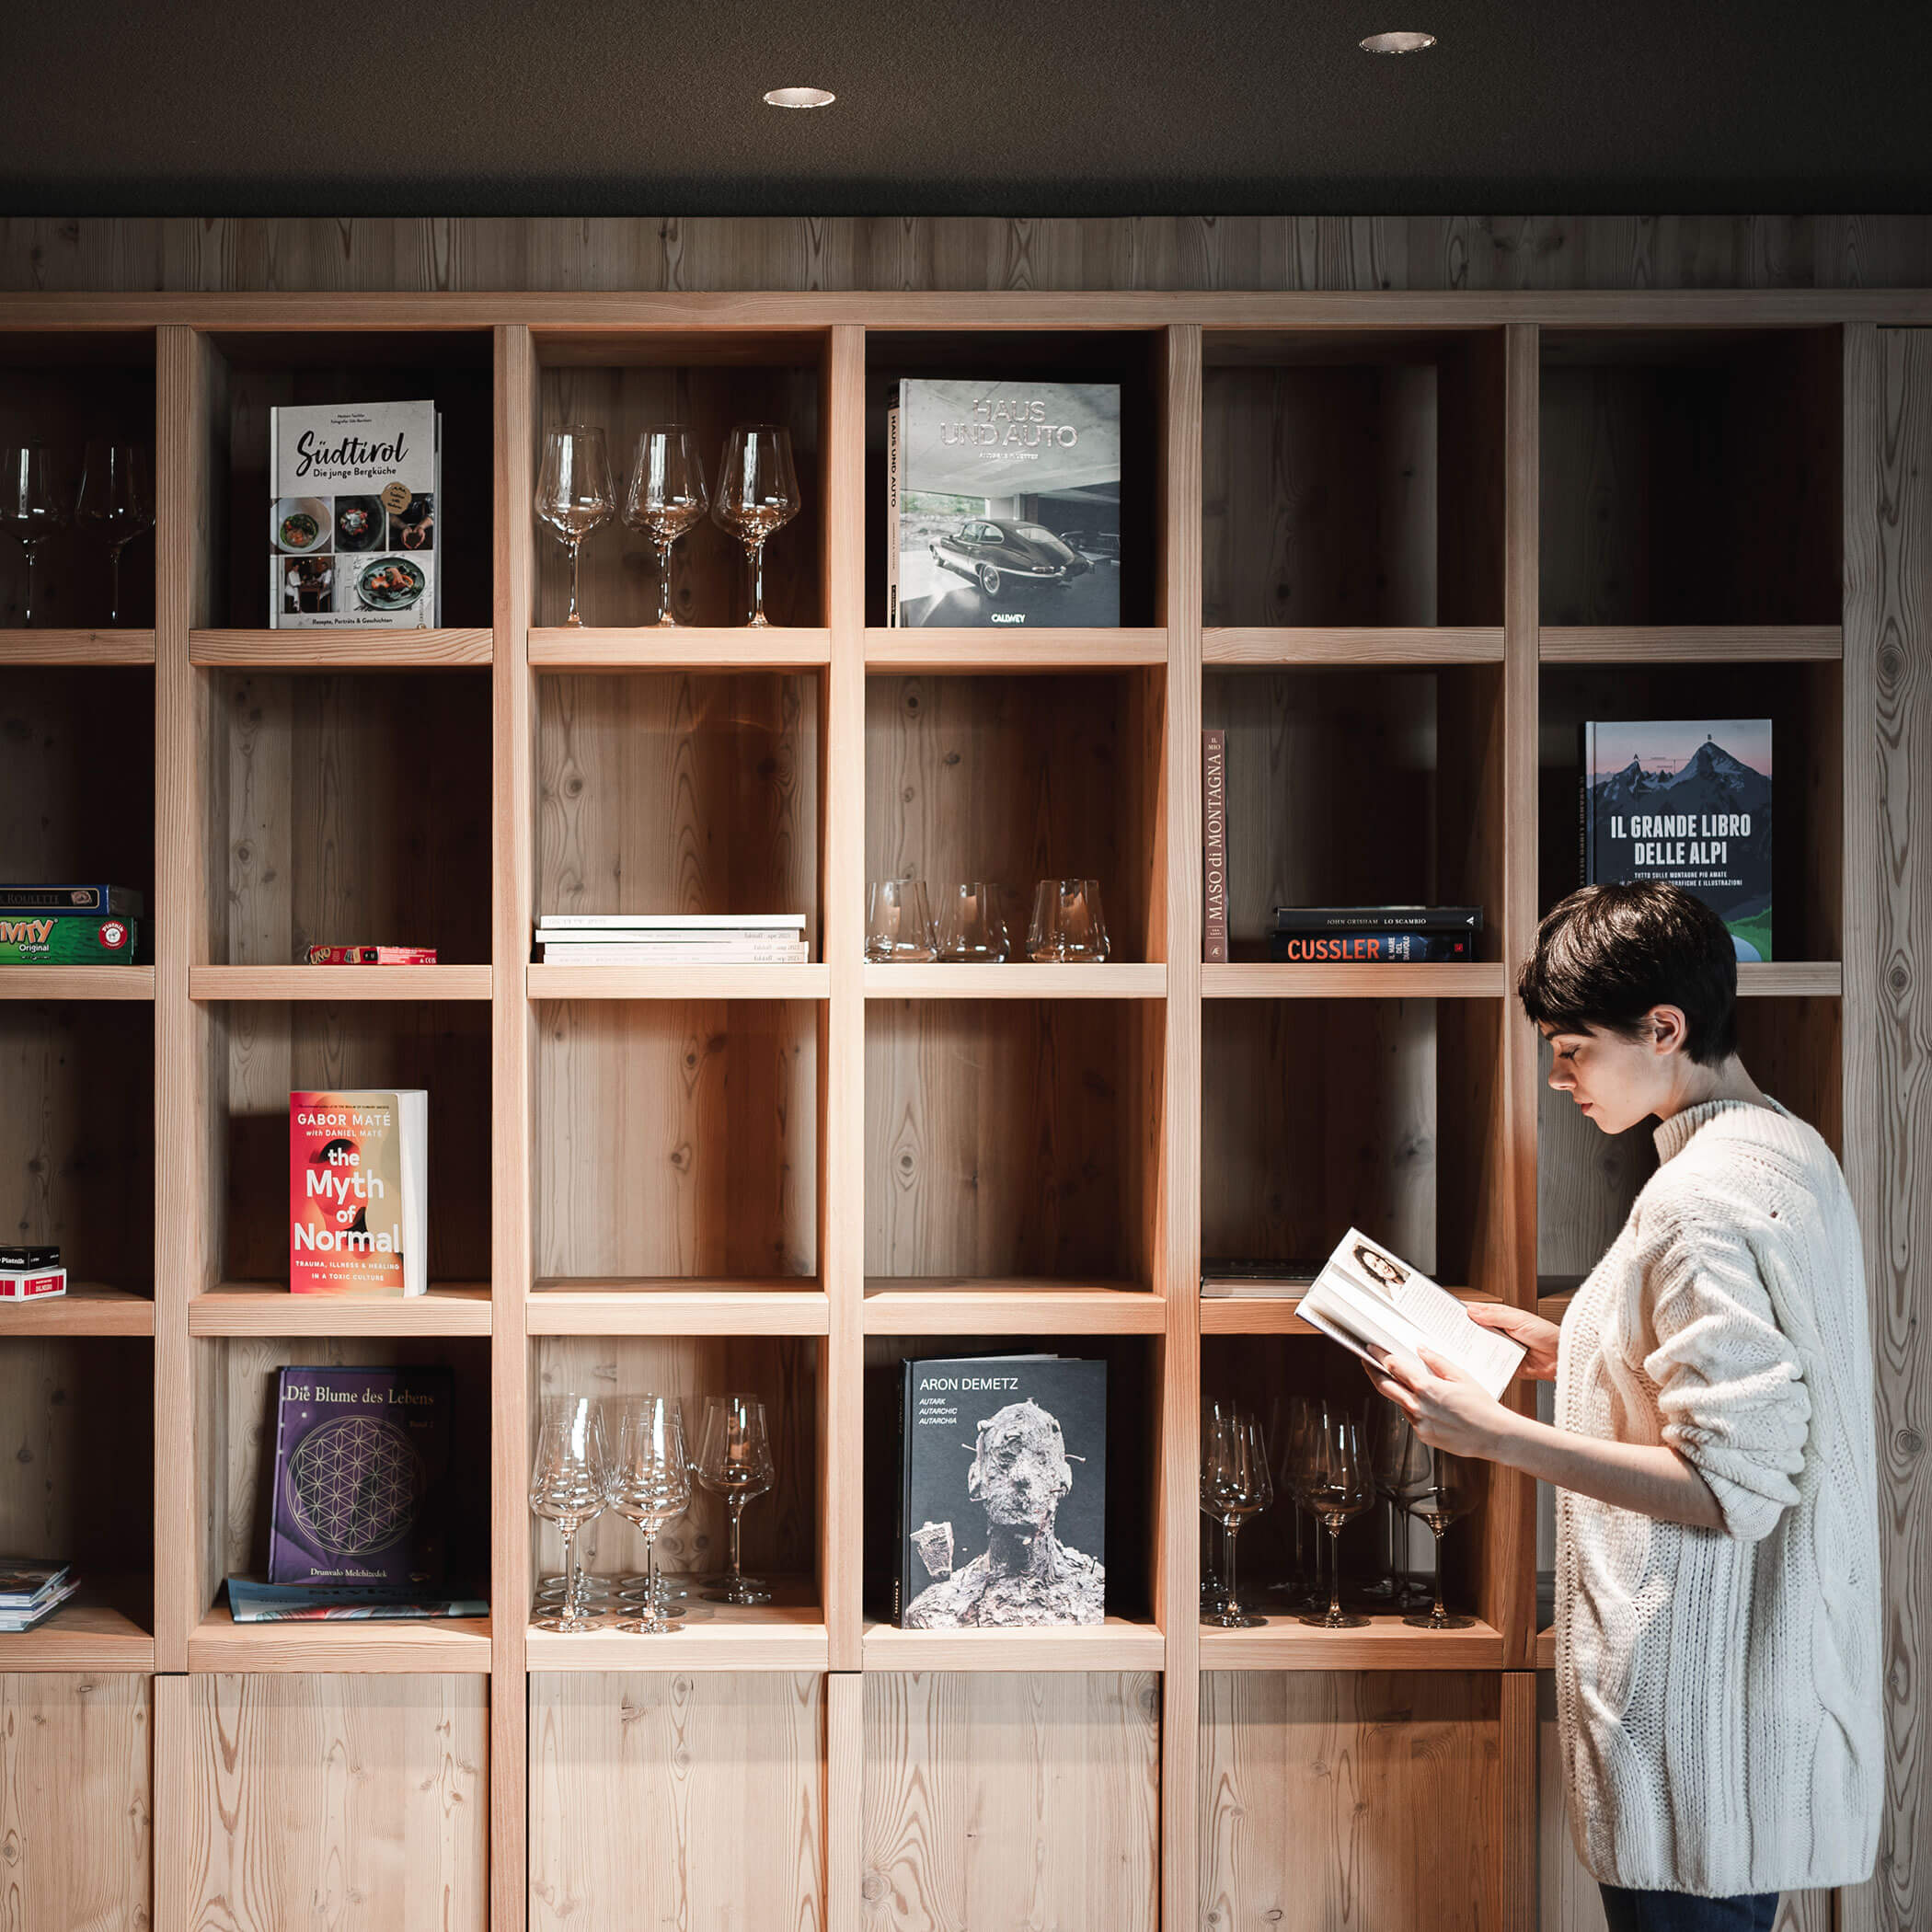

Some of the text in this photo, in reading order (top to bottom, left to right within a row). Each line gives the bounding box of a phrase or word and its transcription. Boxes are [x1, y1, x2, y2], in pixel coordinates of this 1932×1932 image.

[972, 399, 1046, 423] HAUS
[939, 422, 1078, 448] UND AUTO
[295, 430, 409, 477] Südtirol
[313, 467, 397, 479] Die junge Bergküche
[991, 614, 1026, 624] CALLWEY
[1207, 753, 1222, 848] MONTAGNA
[1611, 814, 1751, 838] IL GRANDE LIBRO
[1208, 852, 1222, 868] di
[1634, 841, 1727, 865] DELLE ALPI
[1208, 870, 1223, 921] MASO
[19, 944, 50, 953] Original
[310, 947, 331, 965] UNO
[1287, 937, 1380, 960] CUSSLER
[297, 1111, 391, 1126] GABOR MATÉ
[325, 1129, 357, 1137] DANIEL
[328, 1147, 361, 1167] the
[306, 1169, 385, 1204] Myth
[336, 1205, 356, 1224] of
[293, 1222, 401, 1253] Normal
[295, 1260, 326, 1269] TRAUMA,
[368, 1262, 399, 1271] HEALING
[920, 1378, 1018, 1391] ARON DEMETZ
[286, 1385, 434, 1405] Die Blume des Lebens
[310, 1568, 387, 1578] Drunvalo Melchizedek
